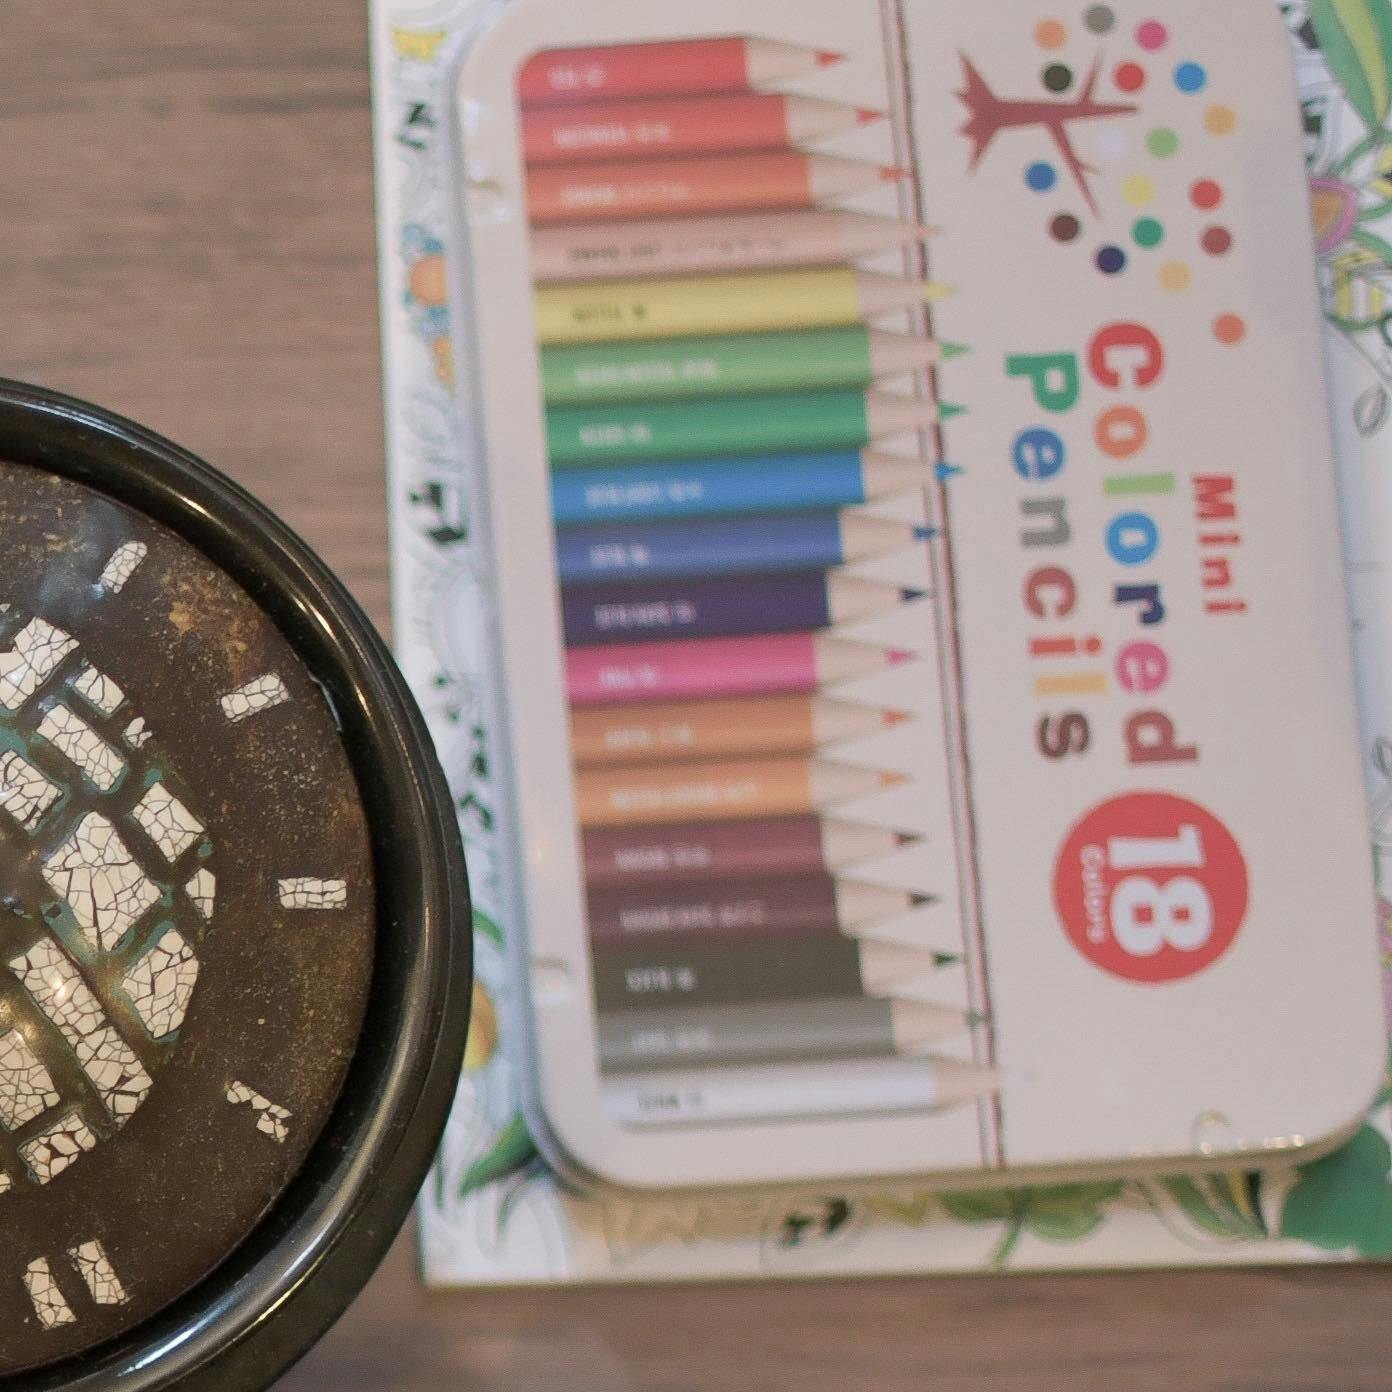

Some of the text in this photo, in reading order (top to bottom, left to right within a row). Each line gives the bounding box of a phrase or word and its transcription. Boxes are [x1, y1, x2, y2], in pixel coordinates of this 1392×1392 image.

[1006, 352, 1106, 762] Pencils
[1086, 322, 1198, 767] Colored
[1192, 473, 1247, 616] Mini
[1107, 823, 1214, 956] 18
